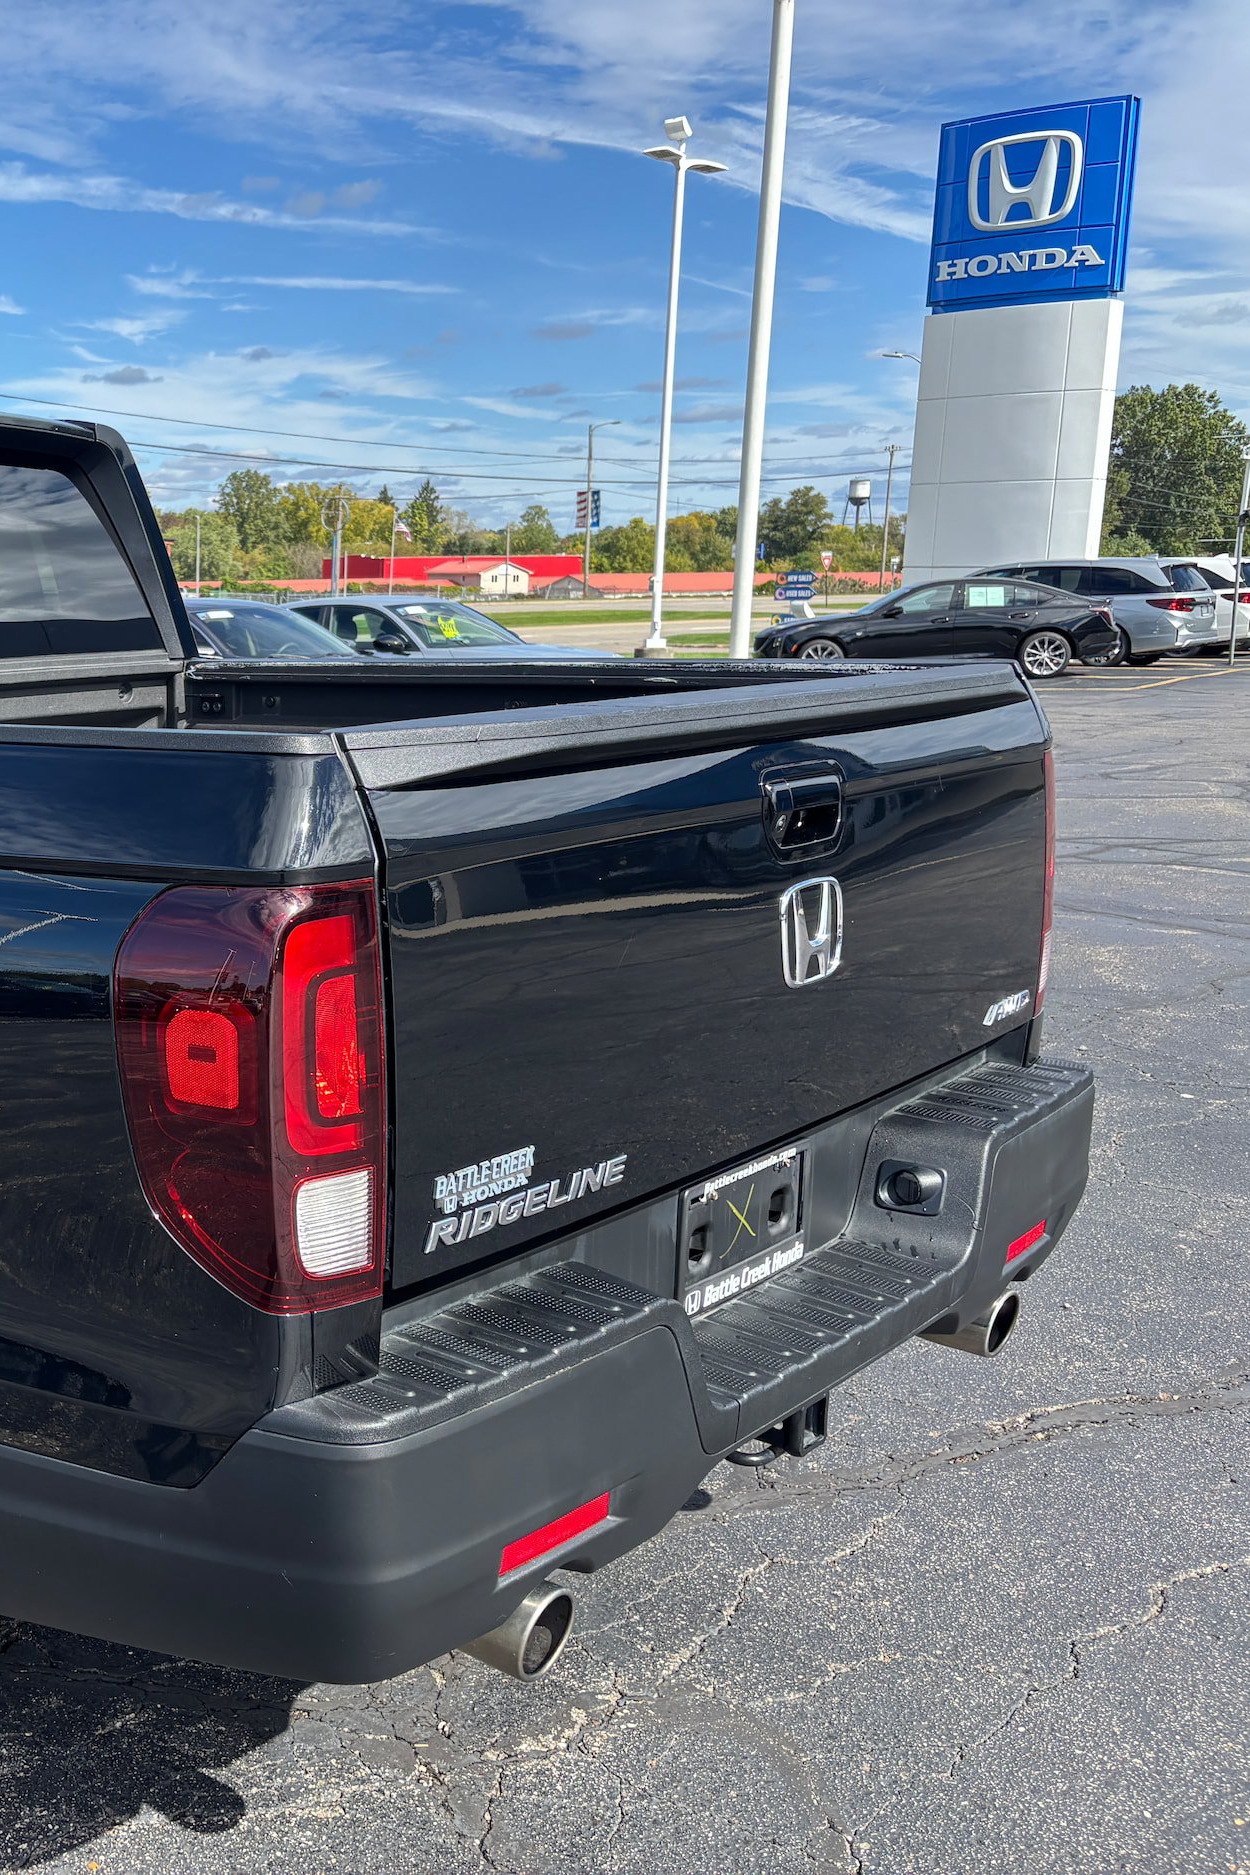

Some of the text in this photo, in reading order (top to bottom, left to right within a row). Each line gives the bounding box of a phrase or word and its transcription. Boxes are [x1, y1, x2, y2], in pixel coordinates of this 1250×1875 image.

[935, 245, 1105, 282] HONDA
[434, 1145, 535, 1200] BATTLE CREEK
[461, 1172, 529, 1207] HONDA
[424, 1154, 628, 1255] RIDGELINE
[703, 1240, 804, 1308] Battle Creek Honda
